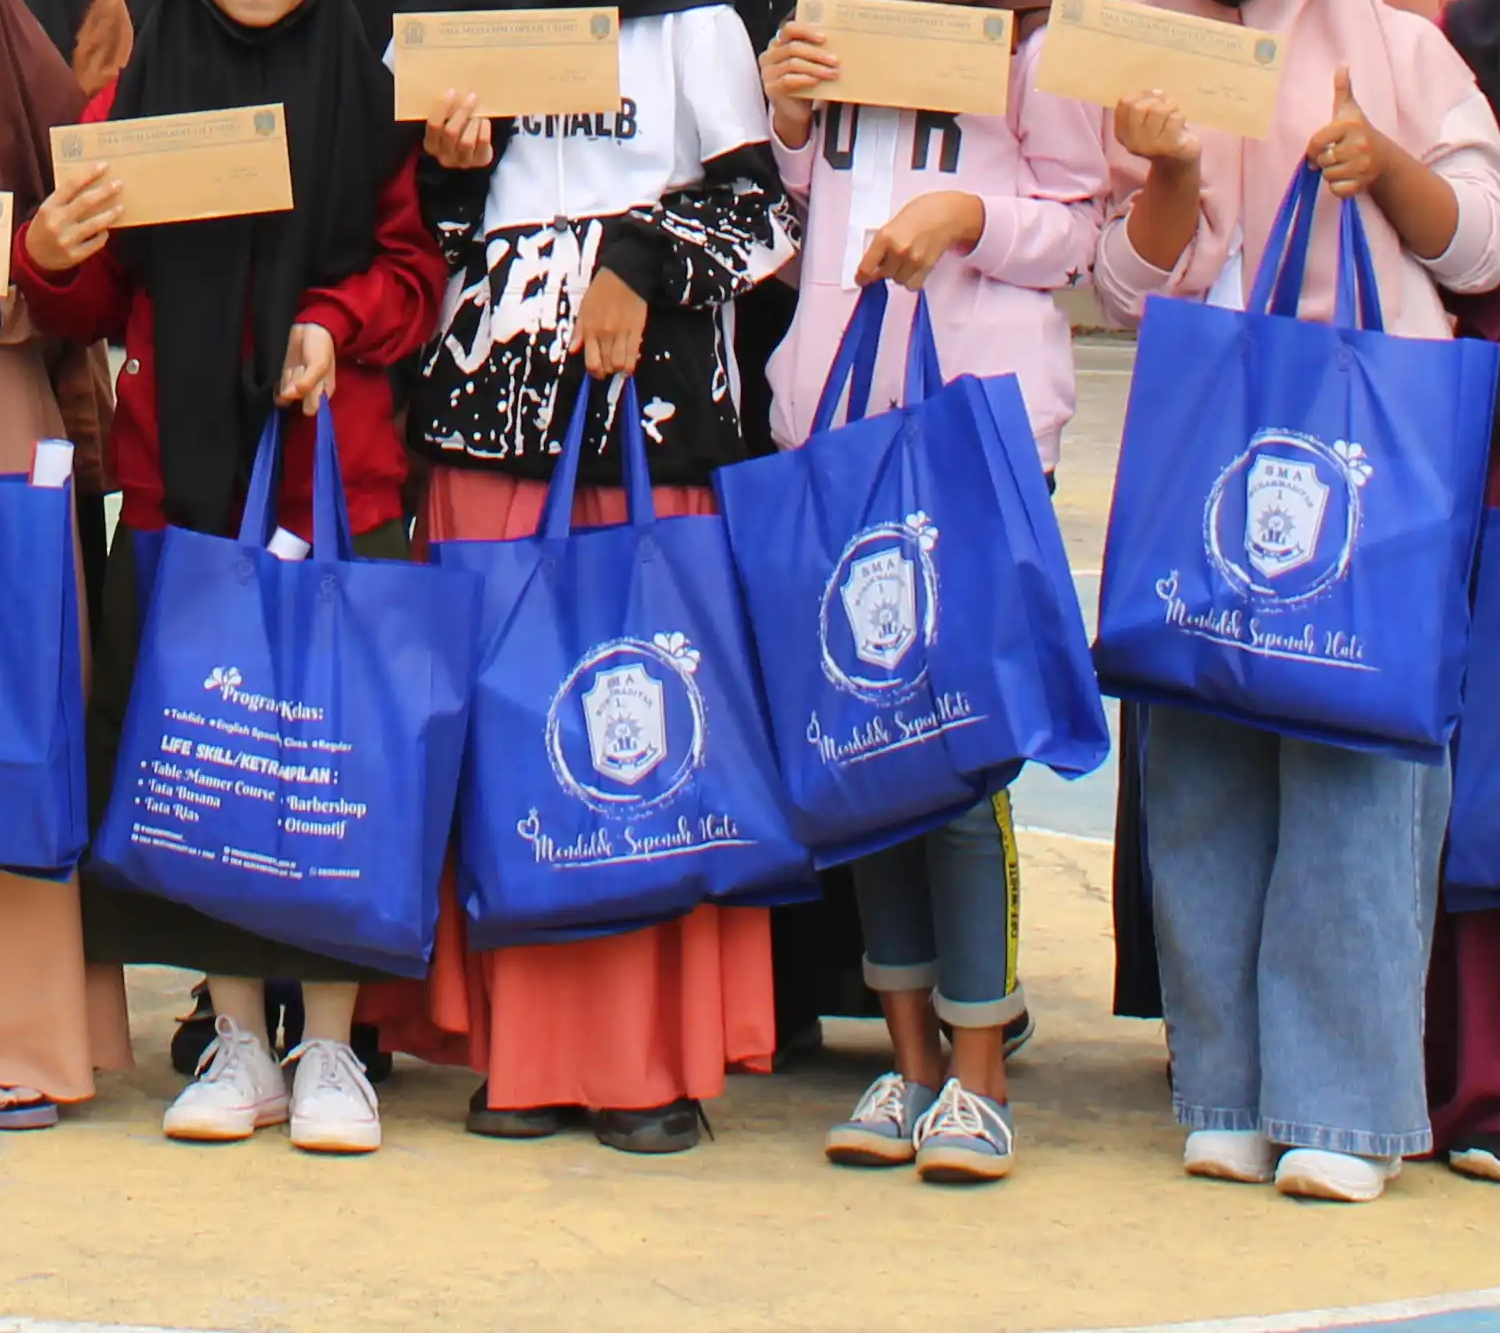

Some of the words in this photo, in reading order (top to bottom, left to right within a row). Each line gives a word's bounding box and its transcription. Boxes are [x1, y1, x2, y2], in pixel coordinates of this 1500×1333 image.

[1264, 465, 1303, 482] SMA
[1165, 598, 1242, 640] Mendidik
[1249, 615, 1314, 657] Sepenuh
[1324, 631, 1364, 659] Hati
[220, 684, 277, 714] Progra
[161, 735, 193, 756] LIFE
[148, 778, 174, 797] Tata
[175, 784, 221, 809] Busana
[152, 760, 183, 779] Table
[184, 768, 235, 792] Manner
[235, 780, 276, 804] Course
[145, 796, 171, 815] Tata
[287, 794, 368, 819] Barbershop
[284, 817, 349, 840] Otomotif
[535, 828, 613, 863] Mendidik
[624, 816, 693, 861] Sepenuh
[700, 814, 740, 839] Hati
